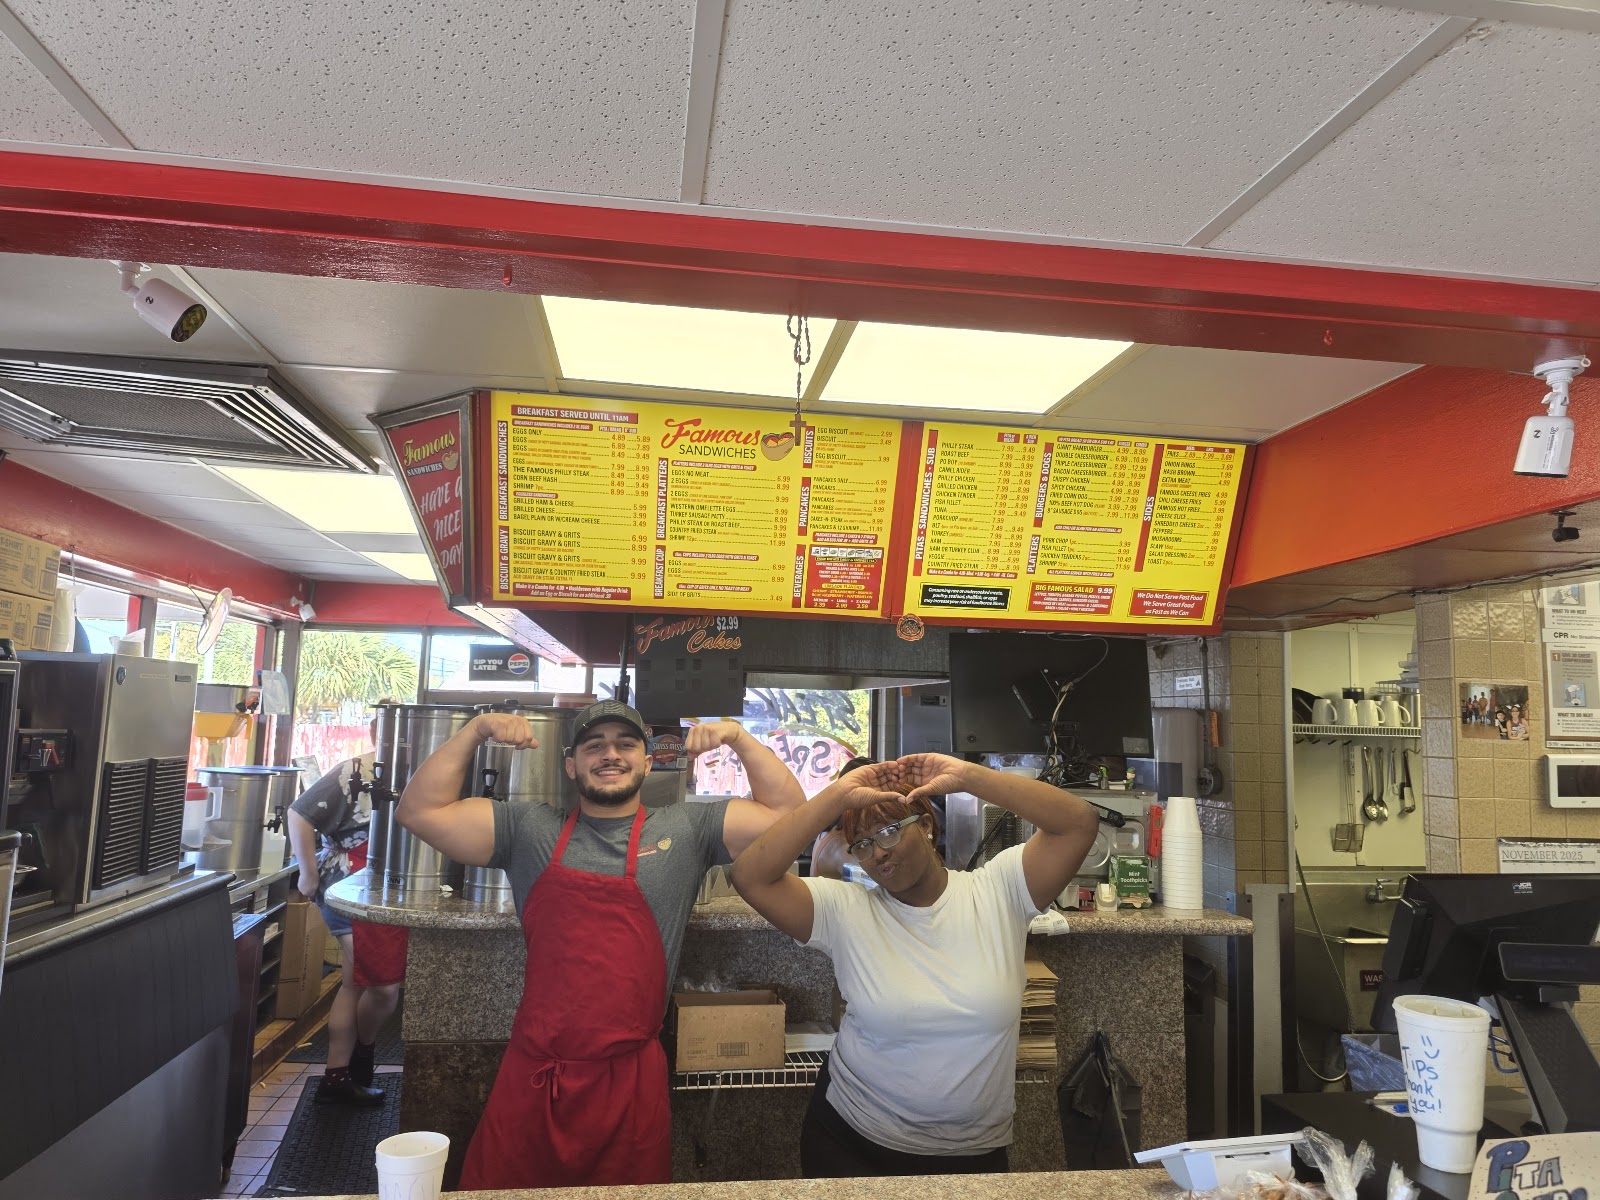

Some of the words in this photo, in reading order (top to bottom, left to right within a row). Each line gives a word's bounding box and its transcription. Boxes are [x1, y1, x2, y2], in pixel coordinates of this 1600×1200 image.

[517, 406, 558, 418] BREAKFAST
[560, 409, 590, 419] SERVED
[590, 412, 610, 420] UNTIL
[498, 422, 508, 475] SANDWICHES
[661, 418, 760, 448] Famous
[804, 430, 814, 464] BISCUITS
[404, 431, 456, 467] Famous
[679, 444, 756, 459] SANDWICHES
[926, 448, 936, 465] SUB
[406, 463, 442, 476] SANDWICHES
[658, 460, 668, 497] PLATTERS
[1036, 483, 1047, 518] BURGERS
[1042, 452, 1052, 474] DOGS
[499, 478, 508, 520] BREAKFAST
[799, 486, 810, 527] PANCAKES
[919, 472, 932, 530] SANDWICHES
[1144, 496, 1154, 522] SIDES
[434, 510, 460, 541] NICE
[656, 499, 666, 538] BREAKFAST
[500, 529, 508, 554] GRAVY
[513, 552, 536, 560] BISCUIT
[915, 536, 924, 560] PITAS
[1028, 536, 1040, 573] PLATTERS
[500, 562, 508, 590] BISCUIT
[554, 569, 576, 577] COUNTRY
[654, 562, 664, 597] BREAKFAST
[794, 556, 804, 598] BEVERAGES
[636, 616, 714, 654] Famous
[716, 616, 739, 632] $2.99
[687, 630, 742, 653] Cakes
[1502, 850, 1558, 860] NOVEMBER
[1560, 851, 1583, 860] 2025
[1402, 1046, 1438, 1080] Tips
[1410, 1095, 1442, 1114] you!
